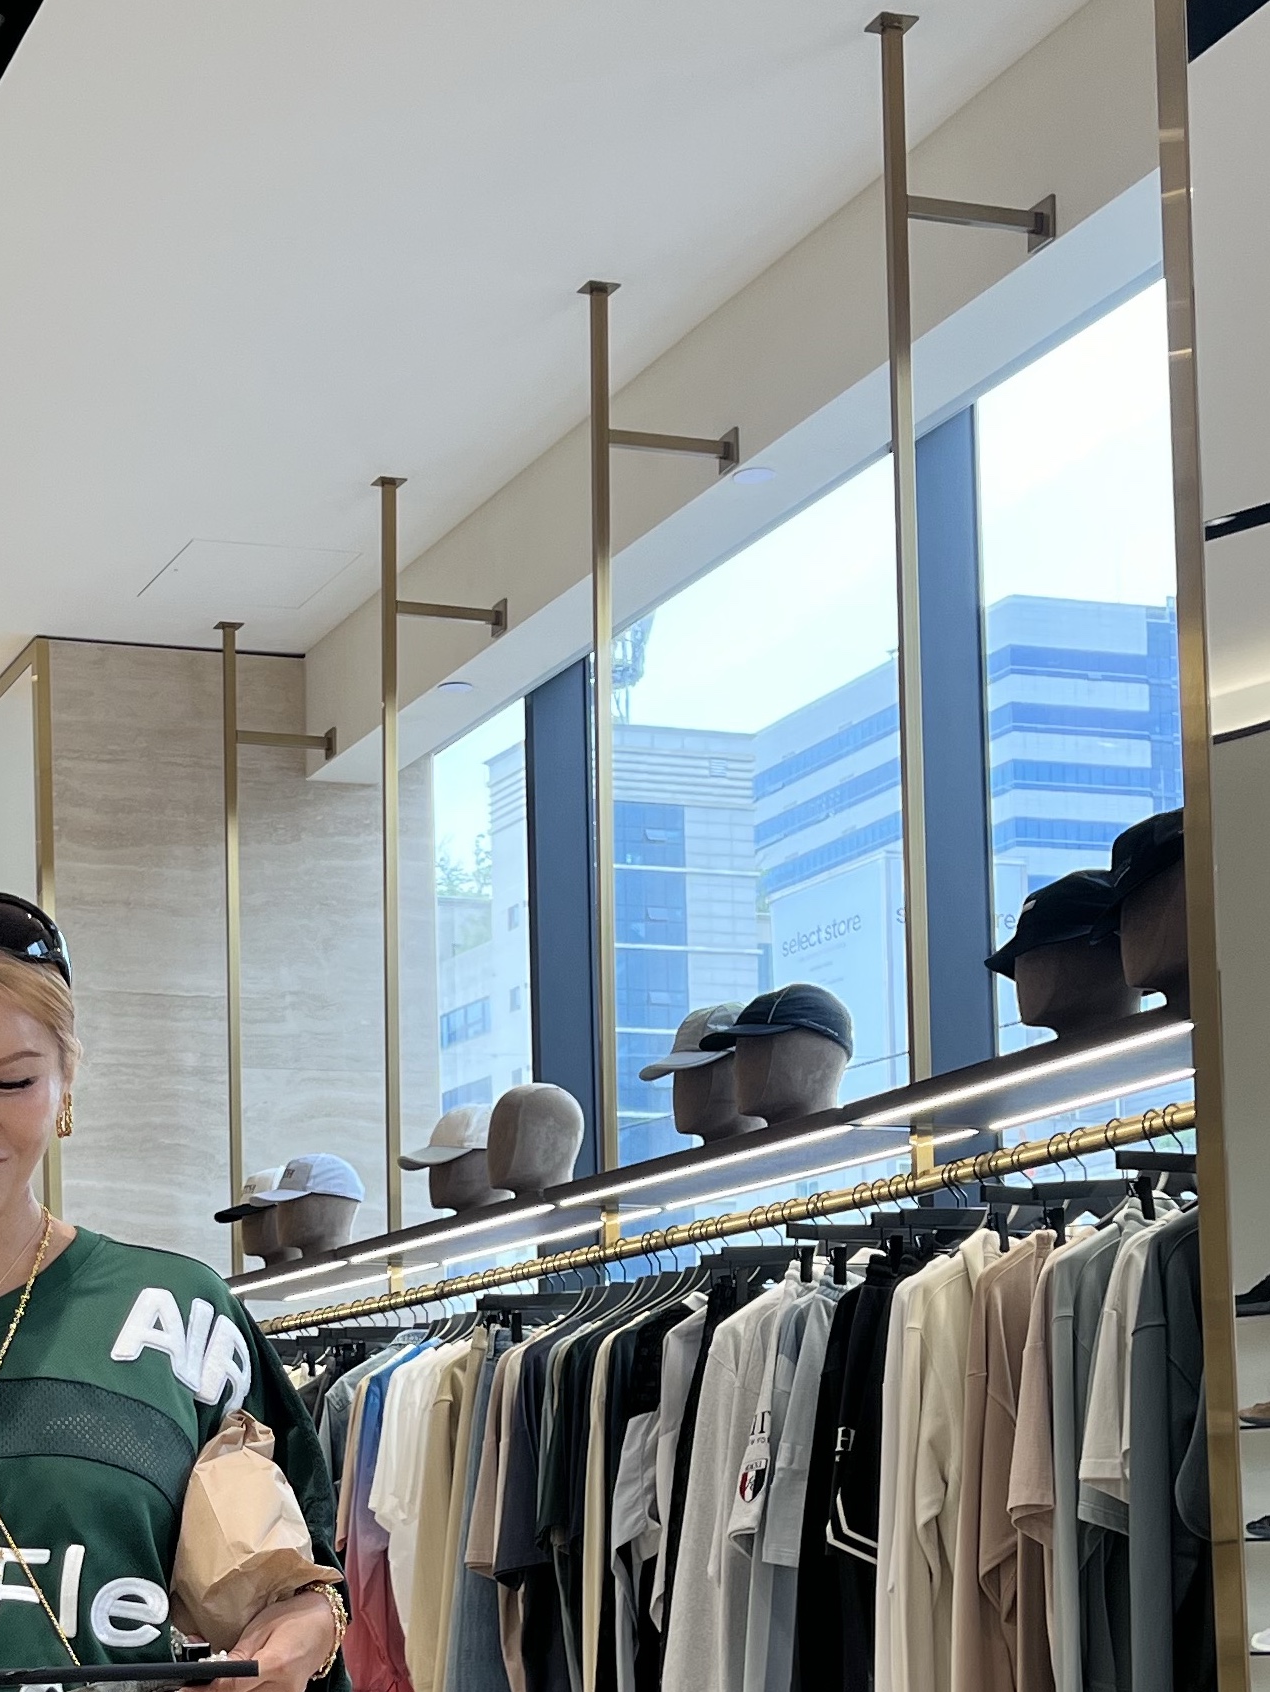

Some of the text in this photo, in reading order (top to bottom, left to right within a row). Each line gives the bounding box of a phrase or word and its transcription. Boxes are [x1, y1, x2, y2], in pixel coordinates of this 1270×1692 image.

[781, 924, 823, 957] select
[823, 913, 862, 943] store
[110, 1287, 252, 1416] AIR
